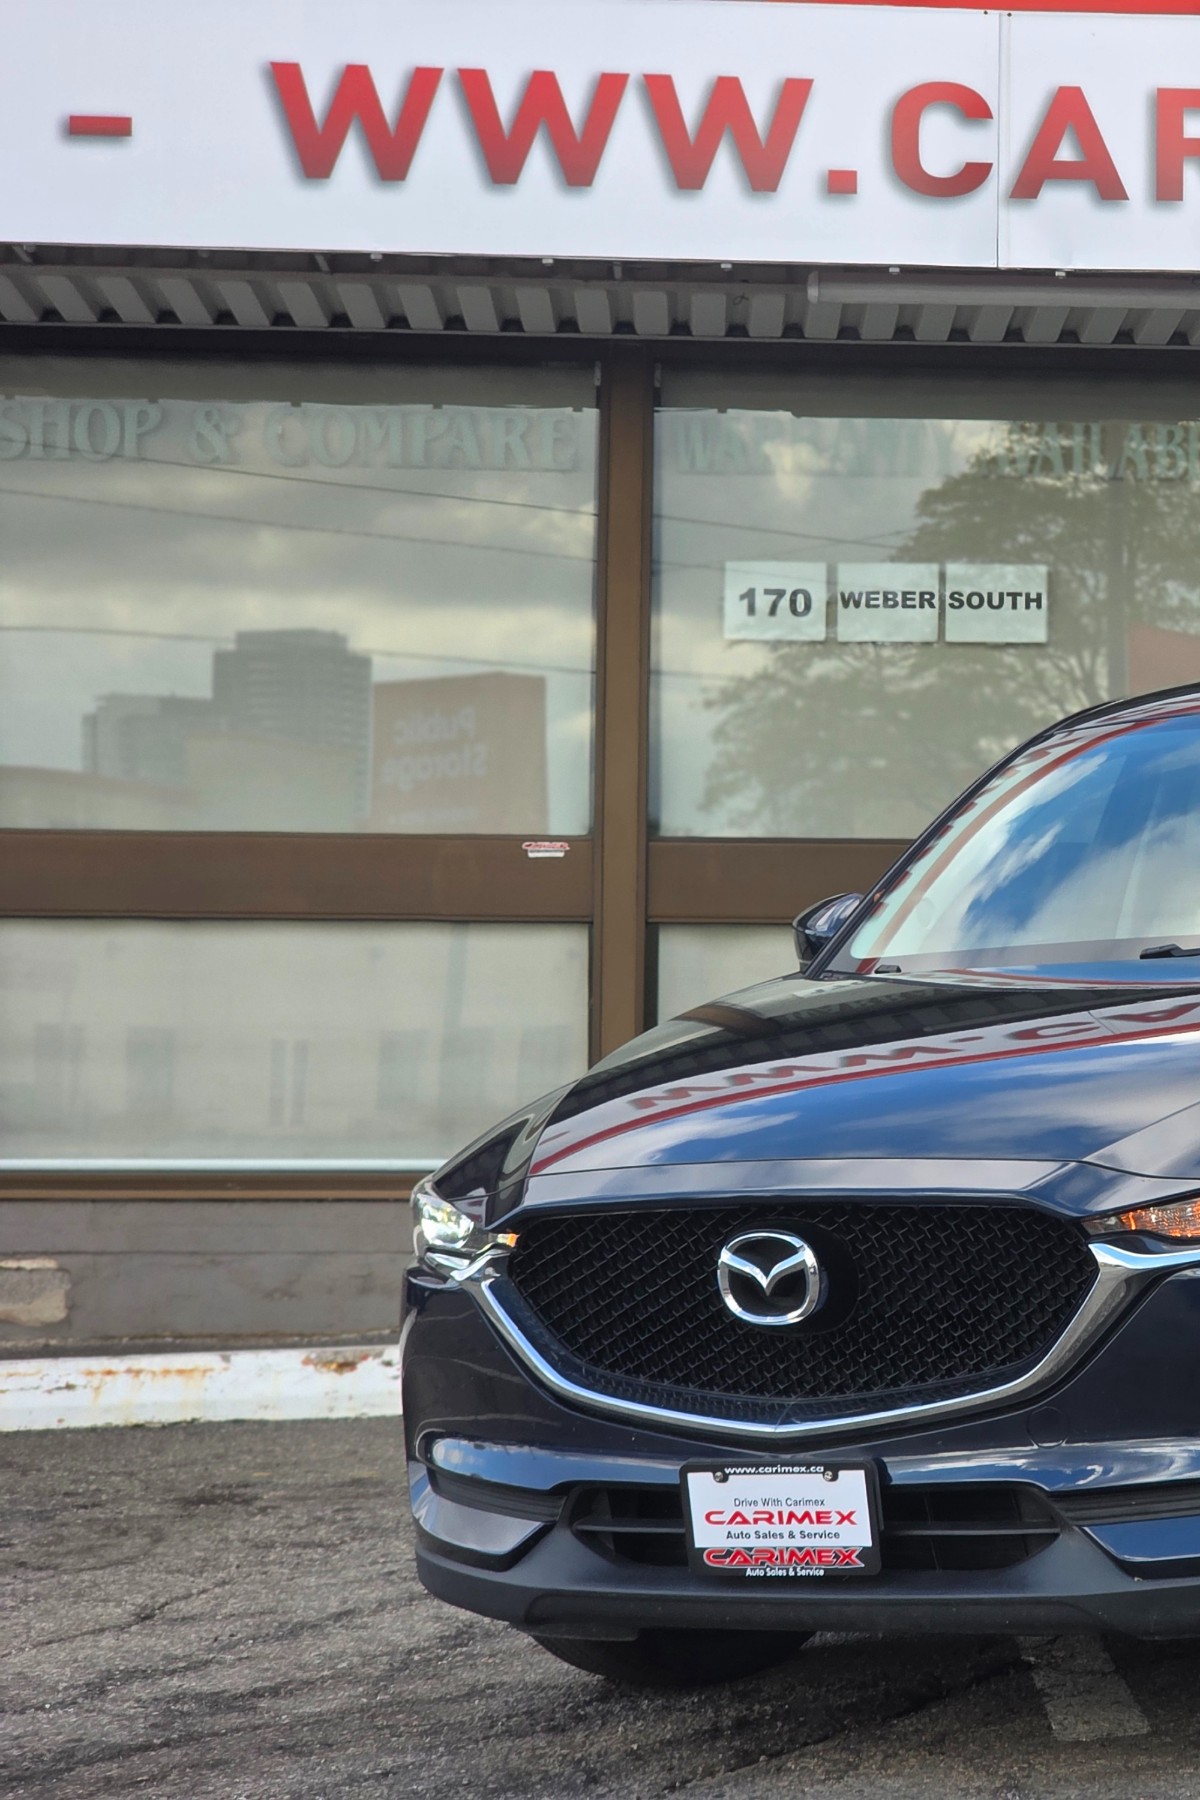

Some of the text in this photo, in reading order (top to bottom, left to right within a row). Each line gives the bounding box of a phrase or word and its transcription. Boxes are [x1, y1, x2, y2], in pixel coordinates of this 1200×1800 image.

[0, 402, 579, 472] SHOP & COMPARE
[738, 587, 1042, 617] 170 WEBER SOUTH
[724, 1465, 824, 1474] www.carimex.ca
[734, 1497, 825, 1507] Drive With Carimex
[704, 1510, 857, 1525] CARIMEX
[726, 1530, 840, 1540] Auto Sales & Service
[703, 1547, 865, 1568] CARIMEX
[745, 1567, 825, 1577] Auto Sales & Service
